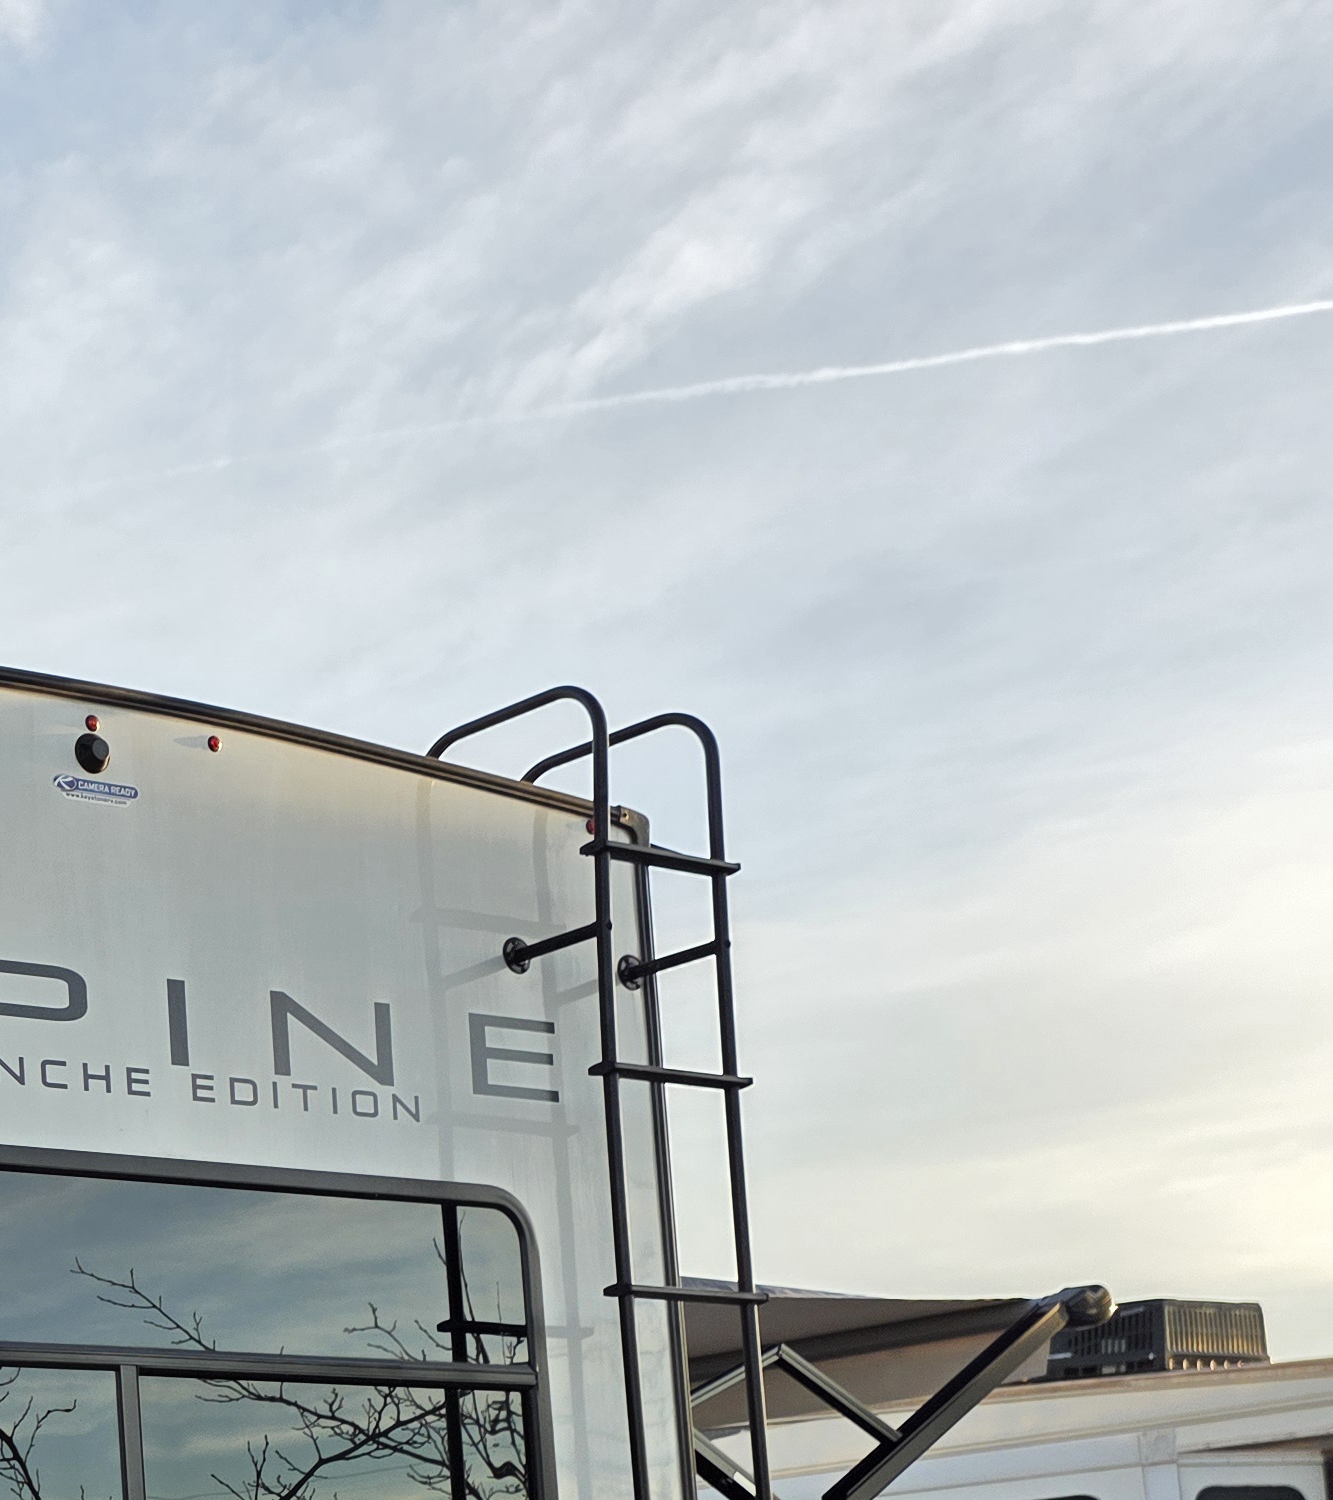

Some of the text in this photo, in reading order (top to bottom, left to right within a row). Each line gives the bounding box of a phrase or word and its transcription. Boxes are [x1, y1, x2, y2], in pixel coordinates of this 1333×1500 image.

[78, 781, 110, 793] CAMERA
[111, 787, 135, 797] READY
[191, 1072, 421, 1123] EDITION
